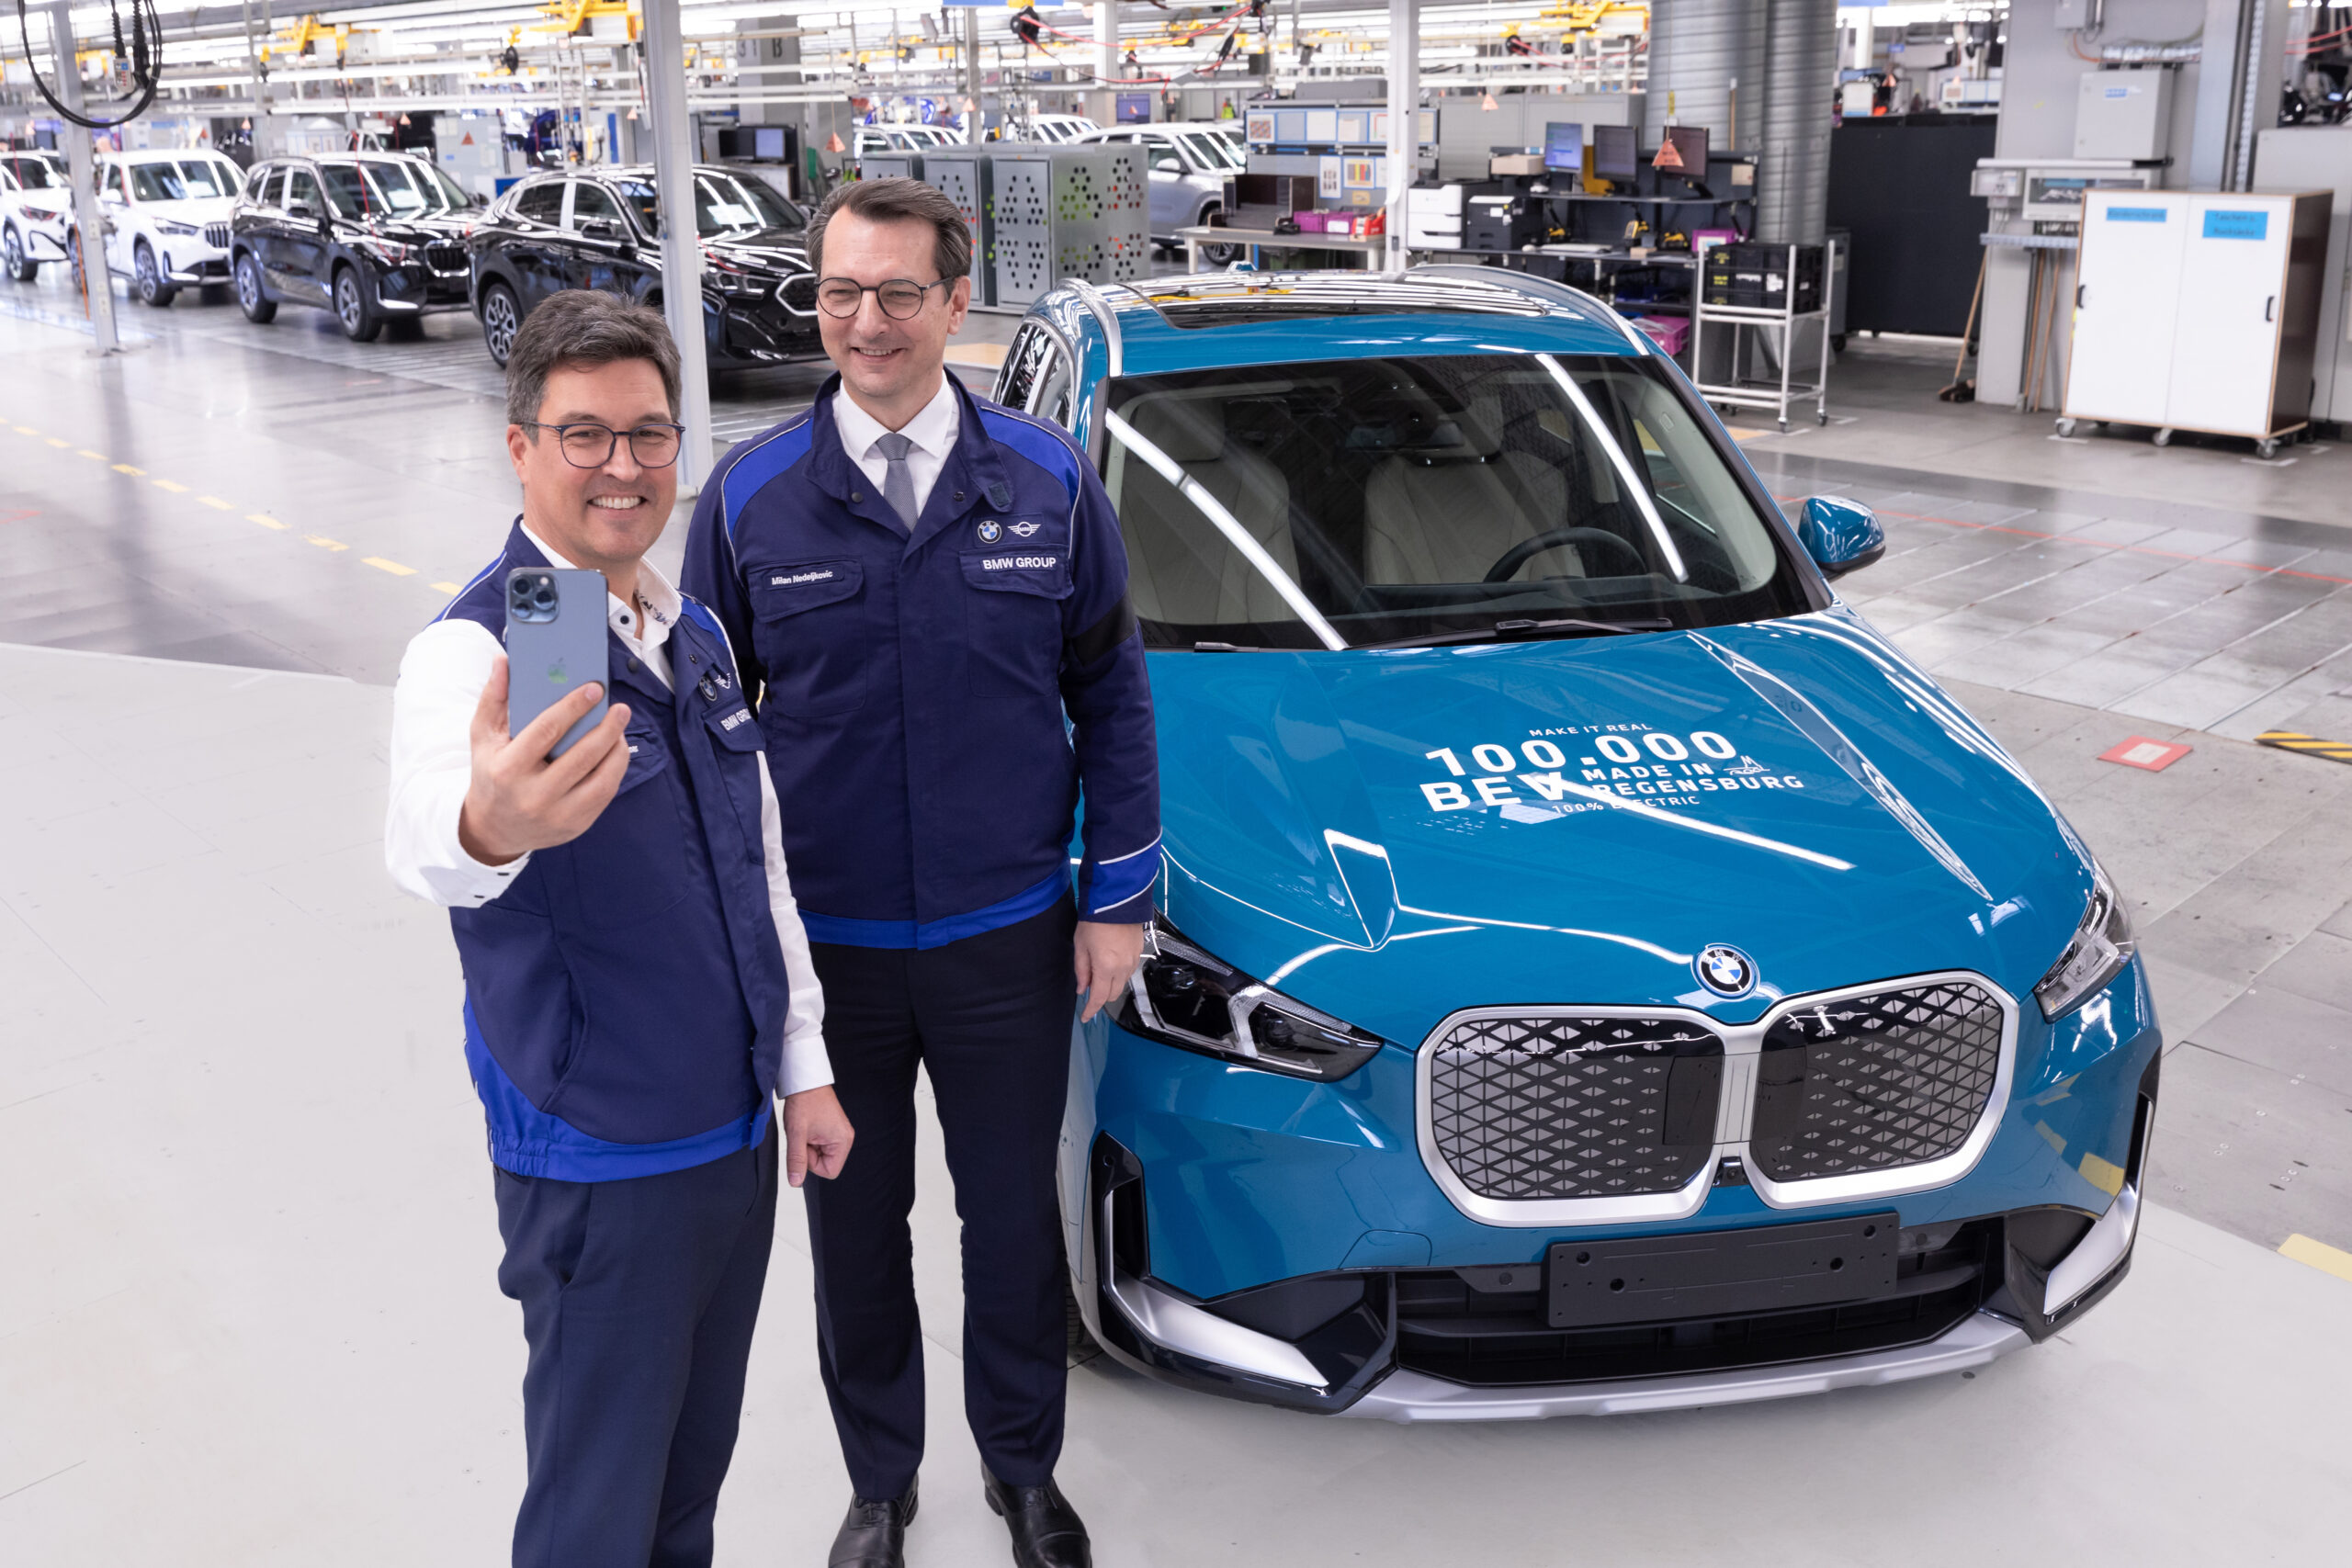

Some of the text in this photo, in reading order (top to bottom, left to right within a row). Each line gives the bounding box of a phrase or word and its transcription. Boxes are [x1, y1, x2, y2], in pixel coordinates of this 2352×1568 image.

[982, 557, 1057, 570] BMW GROUP
[772, 577, 792, 585] Milan
[1529, 723, 1653, 737] MAKE IT REAL
[1425, 731, 1737, 777] 100.000
[1580, 763, 1715, 781] MADE IN
[1590, 776, 1804, 797] REGENSBURG
[1552, 801, 1605, 815] 100%
